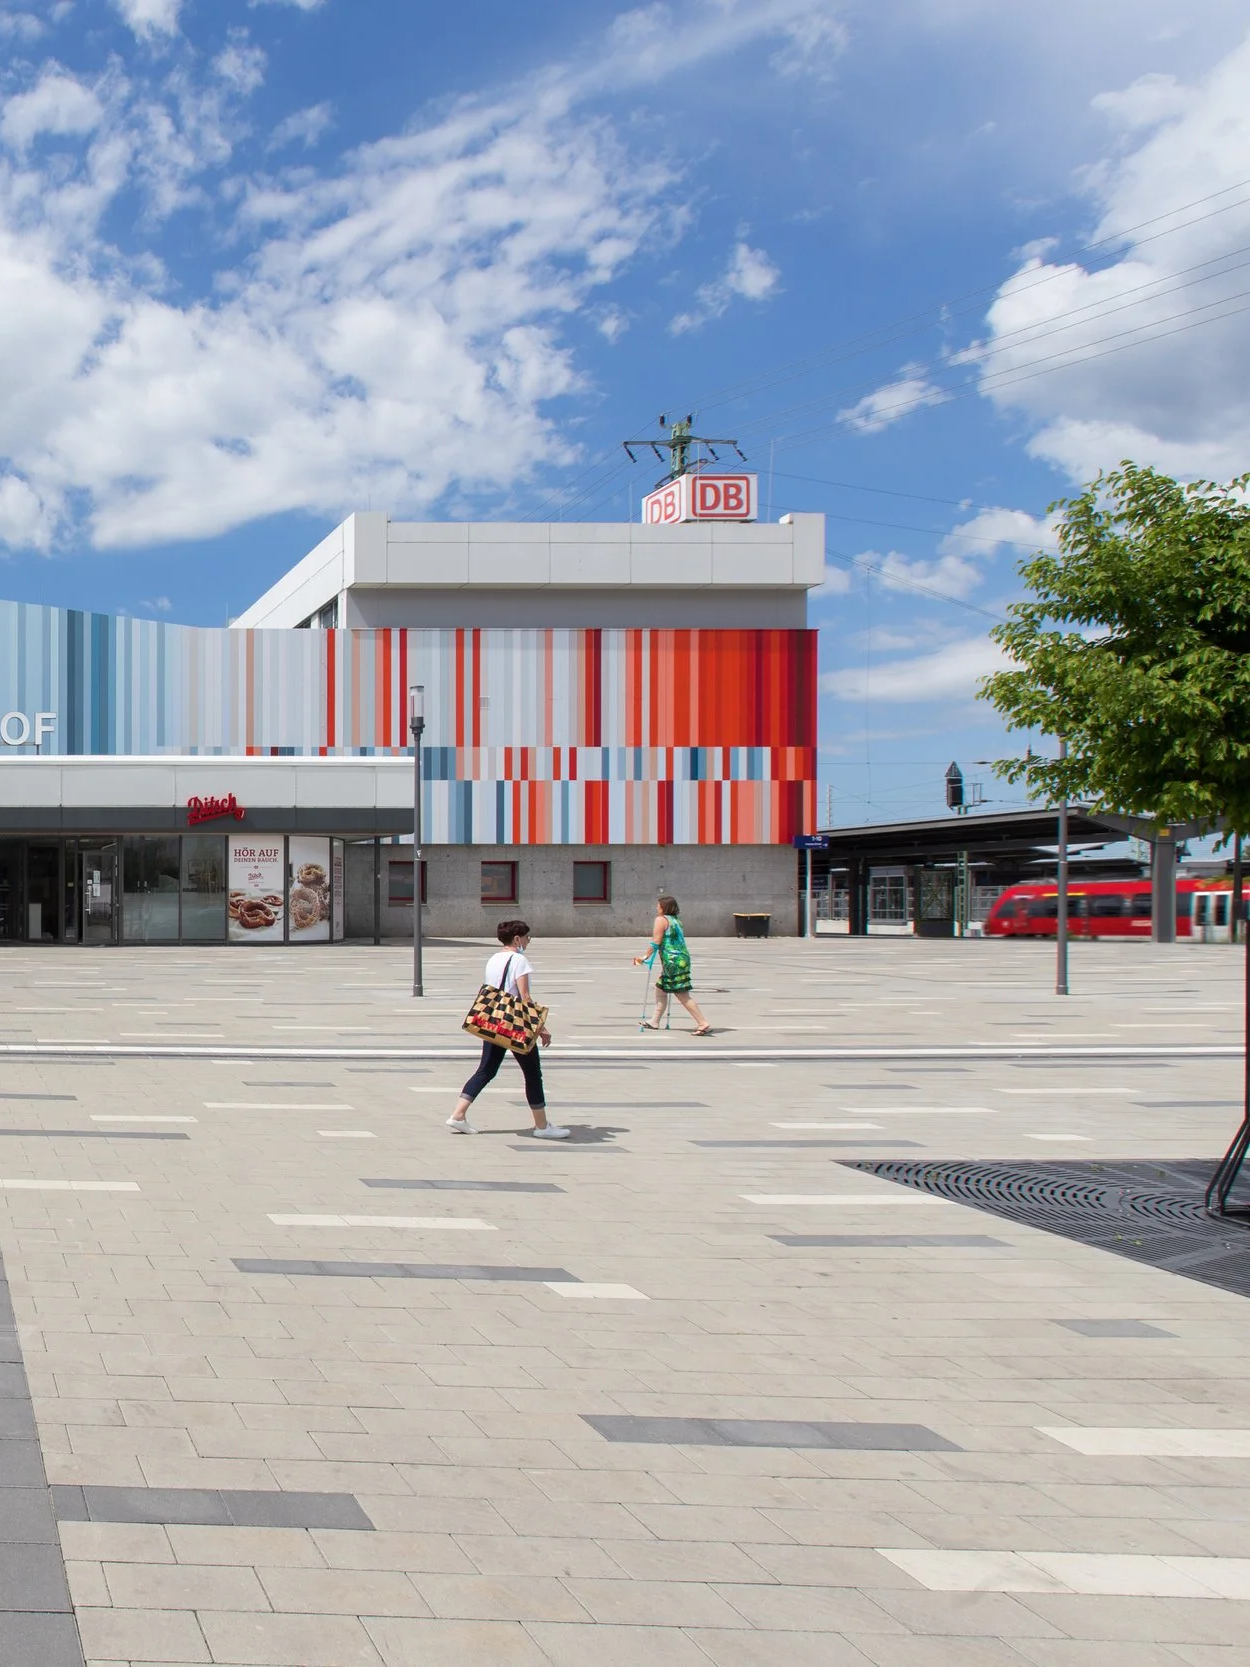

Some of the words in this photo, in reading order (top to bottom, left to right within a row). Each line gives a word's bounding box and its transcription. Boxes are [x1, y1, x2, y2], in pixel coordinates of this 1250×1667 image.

[650, 490, 676, 523] DB
[700, 483, 744, 511] DB
[187, 793, 242, 824] Ditsch
[234, 847, 256, 857] HÖR
[259, 849, 279, 857] AUF
